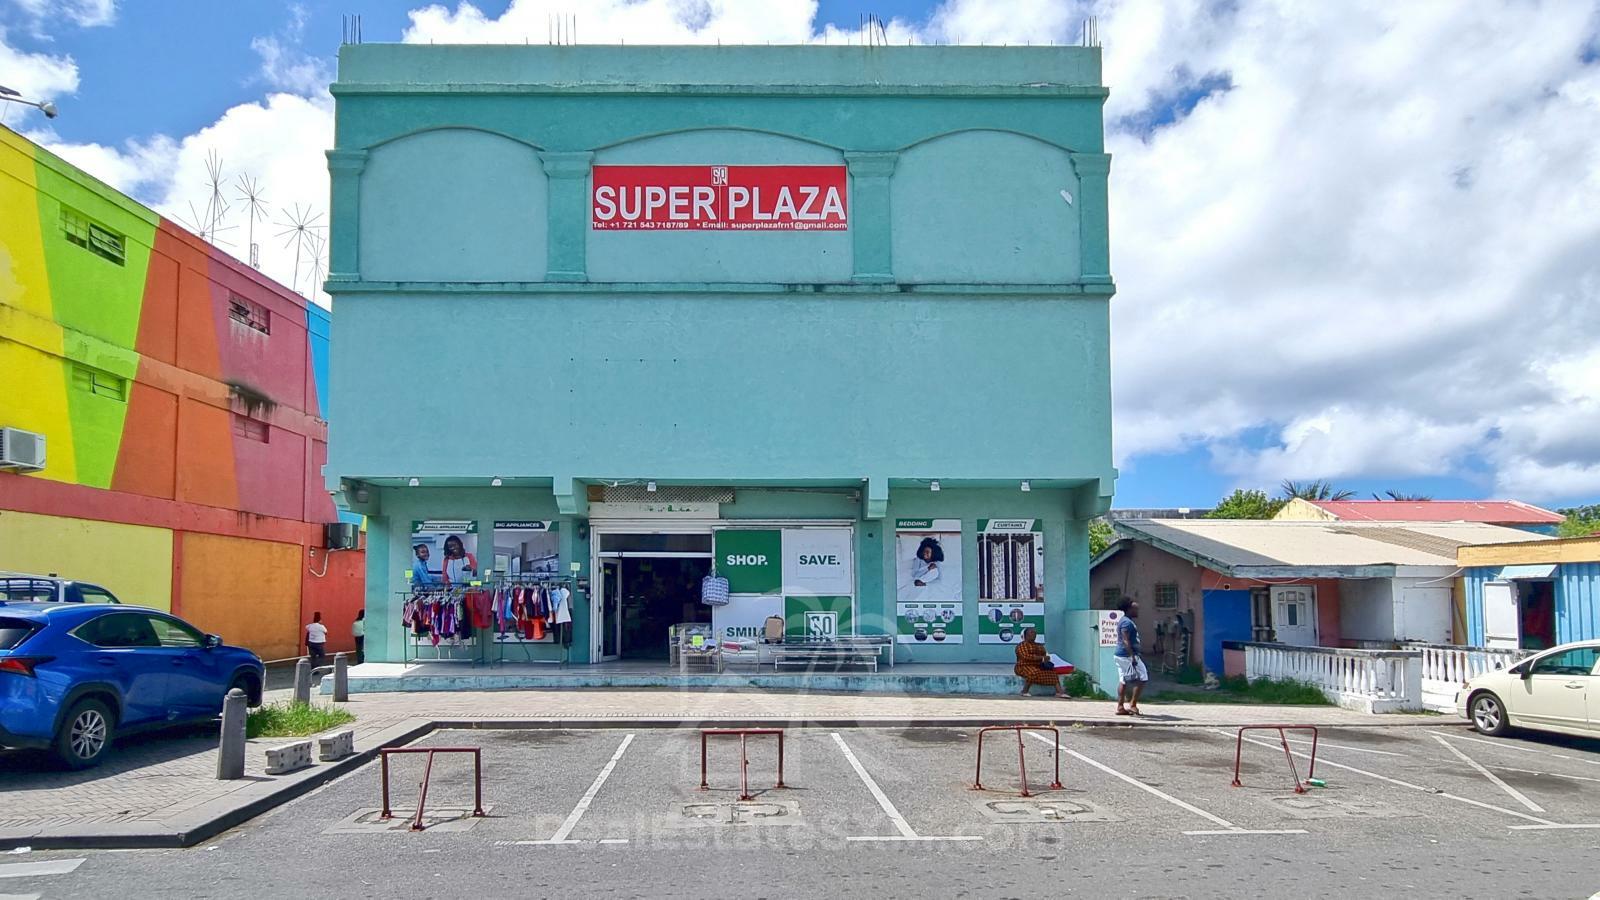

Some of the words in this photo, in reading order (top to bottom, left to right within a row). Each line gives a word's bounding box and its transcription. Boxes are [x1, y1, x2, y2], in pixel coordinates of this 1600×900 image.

[594, 186, 717, 220] SUPER
[728, 186, 847, 220] PLAZA
[731, 222, 847, 230] superplazafrn1@gmail.com
[726, 554, 768, 566] SHOP.
[798, 554, 841, 566] SAVE.
